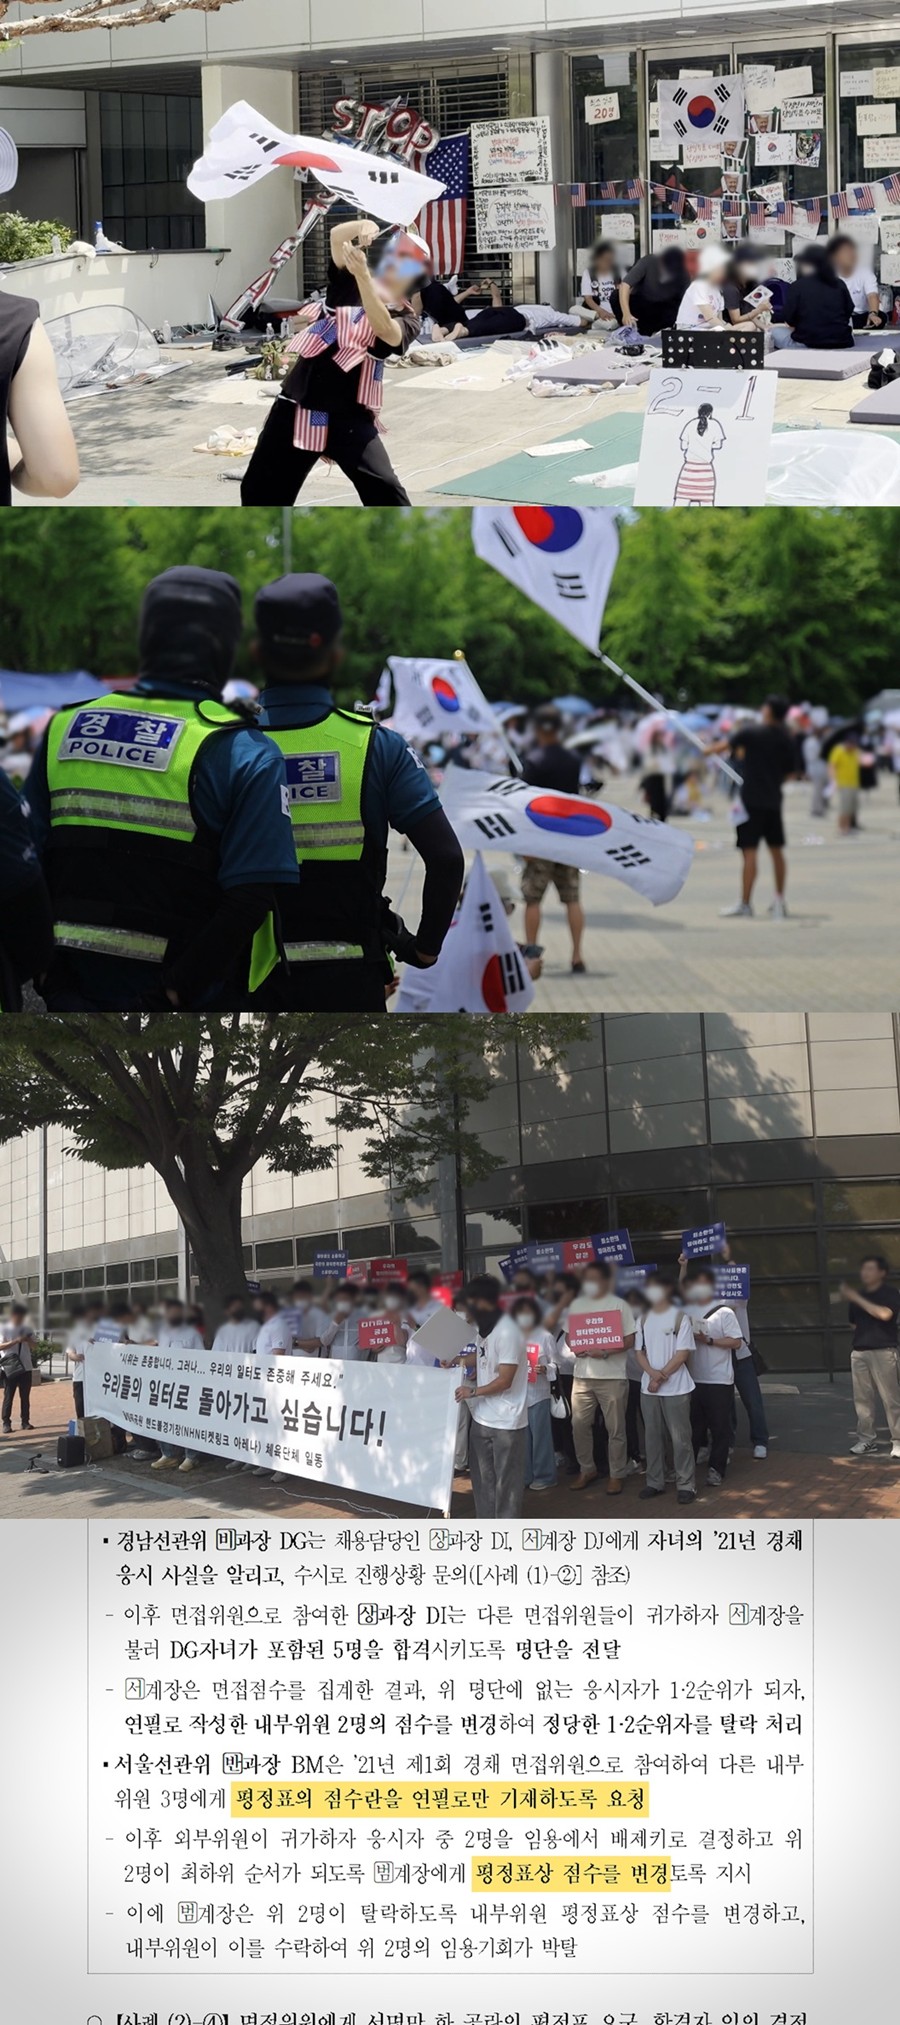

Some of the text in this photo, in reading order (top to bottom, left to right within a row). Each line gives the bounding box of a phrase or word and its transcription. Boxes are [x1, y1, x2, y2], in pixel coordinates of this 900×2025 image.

[331, 95, 441, 162] STOP
[69, 741, 157, 764] POLICE
[141, 1356, 174, 1371] 존중합니다.
[177, 1360, 206, 1375] 그러나...
[209, 1361, 233, 1377] 우리의
[236, 1363, 262, 1380] 일터도
[266, 1367, 295, 1385] 존중해
[300, 1370, 344, 1389] 주세요."
[102, 1371, 387, 1448] 우리들의 일터로 돌아가고 싶습니다!
[233, 1435, 262, 1455] 아레나)
[265, 1442, 300, 1464] 체육단체
[304, 1451, 324, 1469] 일동
[116, 1529, 207, 1553] 경남선관위
[279, 1530, 327, 1551] DG는
[334, 1529, 421, 1553] 채용담당인
[490, 1531, 513, 1553] DI,
[583, 1529, 639, 1552] DJ에게
[647, 1529, 702, 1552] 자녀의
[766, 1529, 803, 1553] 경채
[115, 1563, 152, 1587] 응시
[161, 1563, 219, 1587] 사실을
[226, 1563, 285, 1587] 알리고,
[294, 1563, 348, 1587] 수시로
[354, 1562, 427, 1586] 진행상황
[591, 1563, 631, 1587] 참조)
[123, 1603, 161, 1627] 이후
[171, 1603, 283, 1627] 면접위원으로
[292, 1603, 350, 1628] 참여한
[425, 1604, 467, 1625] DI는
[476, 1603, 514, 1626] 다른
[524, 1603, 633, 1627] 면접위원들이
[646, 1603, 720, 1626] 귀가하자
[728, 1602, 805, 1627] 서계장을
[124, 1638, 622, 1662] 불러 DG자녀가 포함된 5명을 합격시키도록 명단을 전달
[124, 1676, 201, 1702] 서계장은
[212, 1678, 307, 1702] 면접점수를
[317, 1678, 374, 1702] 집계한
[384, 1679, 426, 1702] 결과,
[437, 1678, 455, 1702] 위
[468, 1678, 523, 1701] 명단에
[535, 1678, 574, 1702] 없는
[582, 1678, 660, 1701] 응시자가
[763, 1678, 805, 1702] 되자,
[124, 1712, 183, 1736] 연필로
[188, 1712, 249, 1736] 작성한
[253, 1712, 331, 1736] 내부위원
[337, 1712, 386, 1735] 2명의
[394, 1712, 453, 1736] 점수를
[460, 1712, 534, 1736] 변경하여
[542, 1712, 601, 1736] 정당한
[719, 1712, 759, 1735] 탈락
[765, 1712, 802, 1736] 처리
[114, 1752, 210, 1776] 서울선관위
[290, 1753, 344, 1775] BM은
[405, 1752, 451, 1776] 제1회
[463, 1752, 500, 1777] 경채
[511, 1752, 624, 1776] 면접위원으로
[634, 1752, 708, 1777] 참여하여
[718, 1752, 756, 1775] 다른
[766, 1753, 805, 1776] 내부
[114, 1786, 644, 1811] 위원 3명에게 평정표의 점수란을 연필로만 기재하도록 요청
[125, 1826, 802, 1851] 이후 외부위원이 귀가하자 응시자 중 2명을 임용에서 배제키로 결정하고 위
[124, 1861, 169, 1885] 2명이
[180, 1861, 234, 1885] 최하위
[244, 1861, 302, 1885] 순서가
[310, 1861, 366, 1885] 되도록
[475, 1861, 555, 1885] 평정표상
[563, 1861, 622, 1885] 점수를
[630, 1862, 707, 1885] 변경토록
[715, 1861, 751, 1885] 지시
[126, 1902, 164, 1925] 이에
[266, 1902, 283, 1925] 위
[298, 1902, 345, 1925] 2명이
[360, 1901, 458, 1925] 탈락하도록
[470, 1902, 547, 1925] 내부위원
[561, 1902, 639, 1926] 평정표상
[652, 1902, 710, 1925] 점수를
[723, 1901, 805, 1926] 변경하고,
[125, 1935, 578, 1960] 내부위원이 이를 수락하여 위 2명의 임용기회가 박탈
